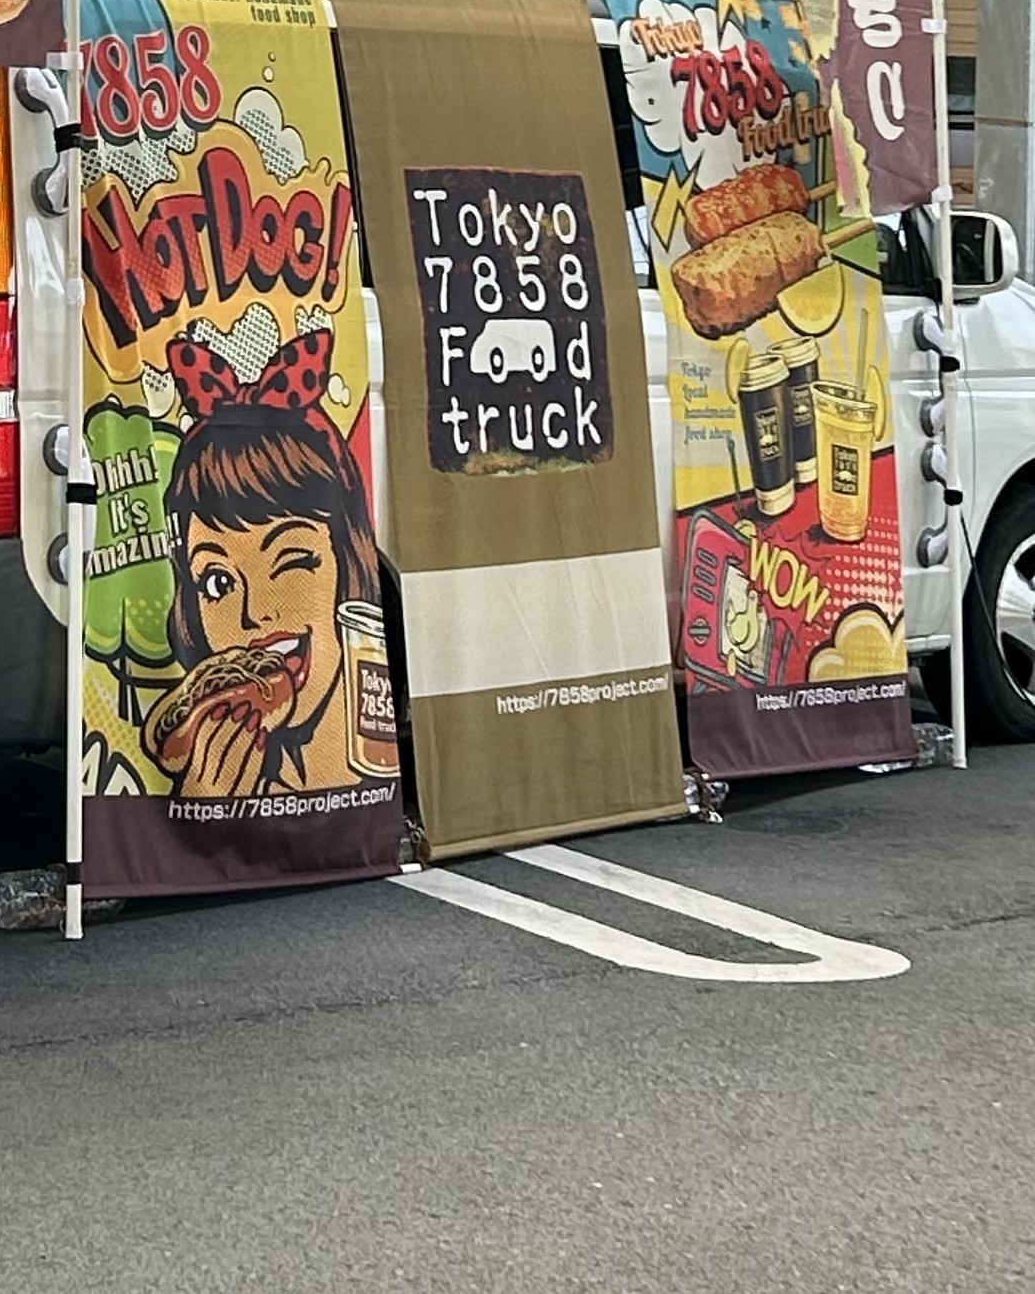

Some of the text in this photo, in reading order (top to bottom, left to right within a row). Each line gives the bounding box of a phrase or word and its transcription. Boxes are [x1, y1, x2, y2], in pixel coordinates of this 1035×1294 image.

[250, 6, 316, 29] food shop
[671, 38, 786, 142] 7858
[413, 187, 578, 252] Tokyo
[423, 253, 590, 314] 7858
[441, 385, 602, 455] truck
[109, 492, 151, 537] It's
[750, 537, 830, 624] WOW
[167, 780, 397, 823] https://7858project.com/
